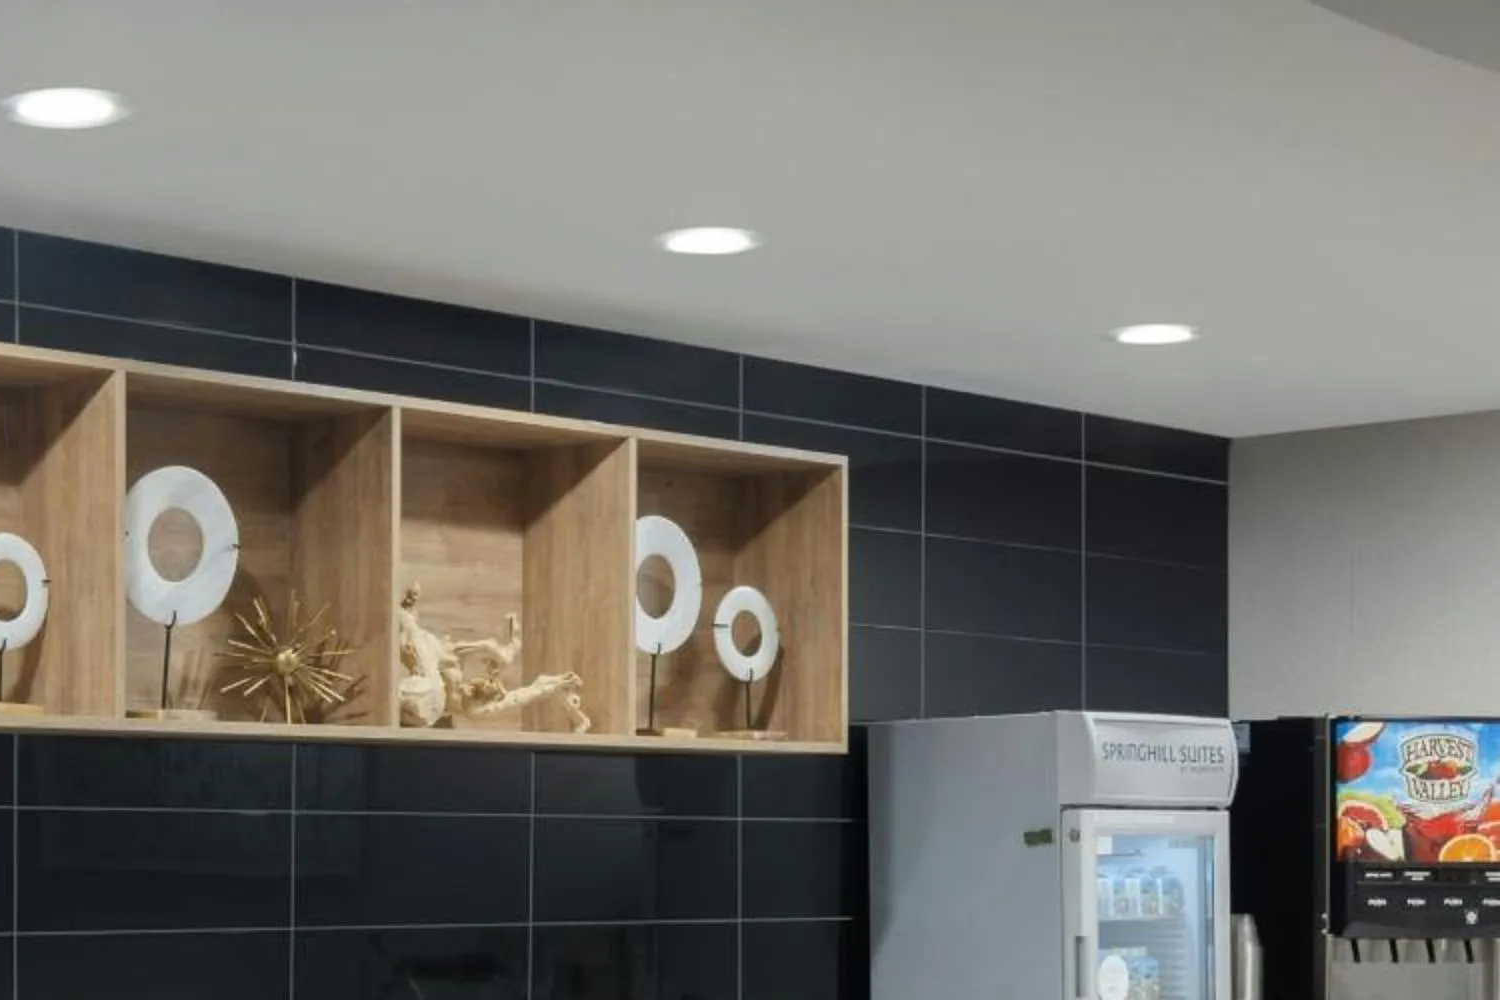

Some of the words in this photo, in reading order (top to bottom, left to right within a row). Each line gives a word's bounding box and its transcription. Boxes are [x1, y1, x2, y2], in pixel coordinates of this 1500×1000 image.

[1101, 741, 1177, 763] SPRINGHILL
[1179, 744, 1225, 764] SUITES
[1405, 738, 1474, 762] HARVEST
[1411, 778, 1468, 801] VALLEY
